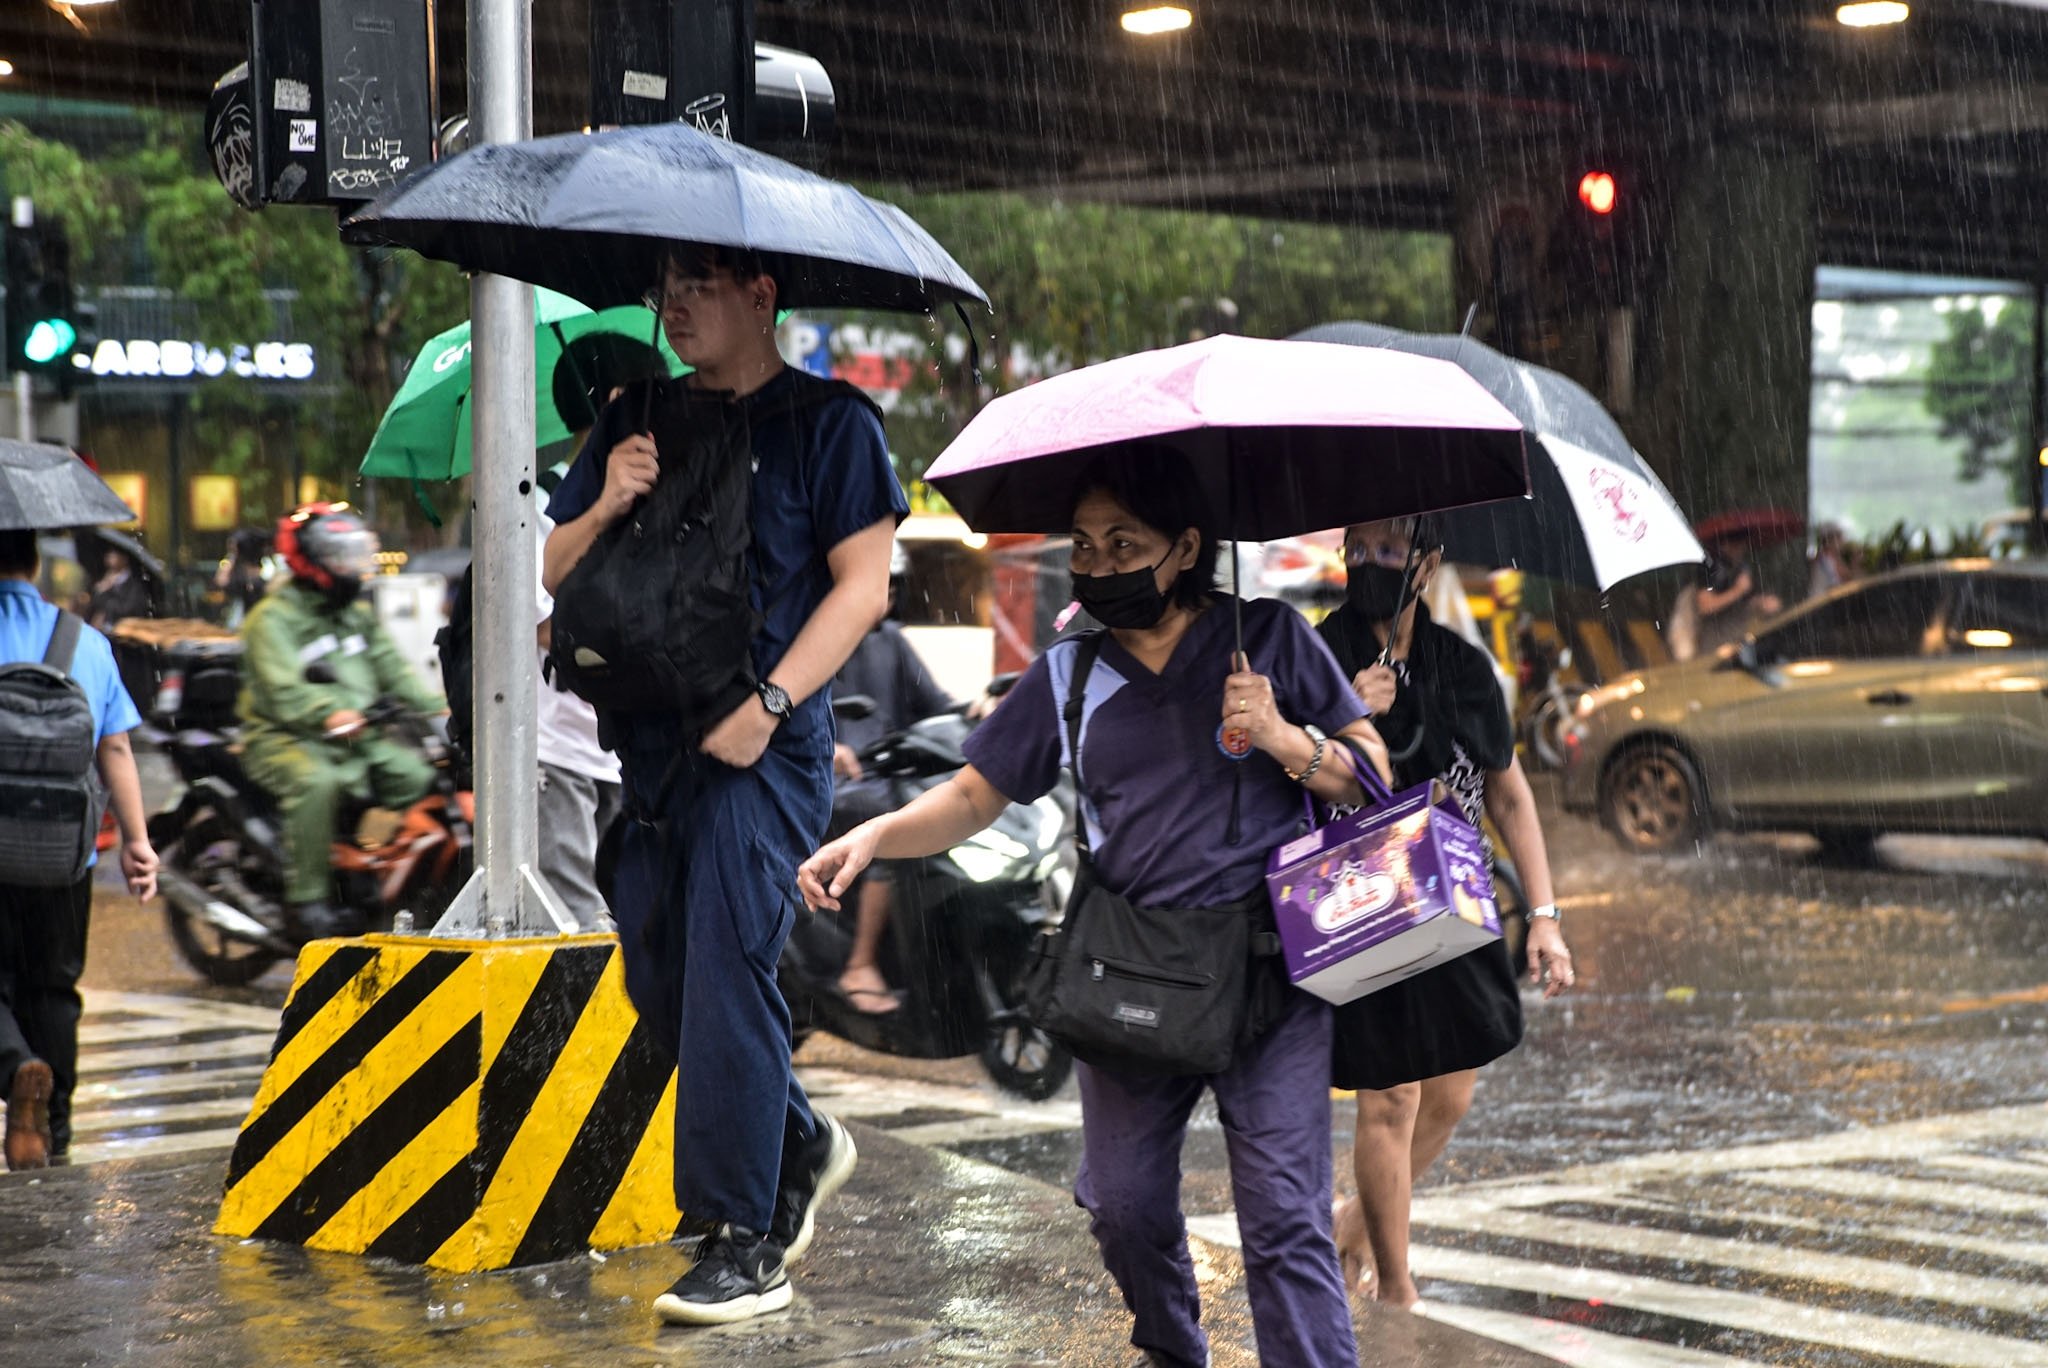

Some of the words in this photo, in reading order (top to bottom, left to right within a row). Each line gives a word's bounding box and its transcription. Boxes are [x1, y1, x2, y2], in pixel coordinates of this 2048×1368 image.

[290, 123, 305, 134] NO
[70, 339, 315, 379] ARBUCKS
[432, 340, 472, 373] Gr
